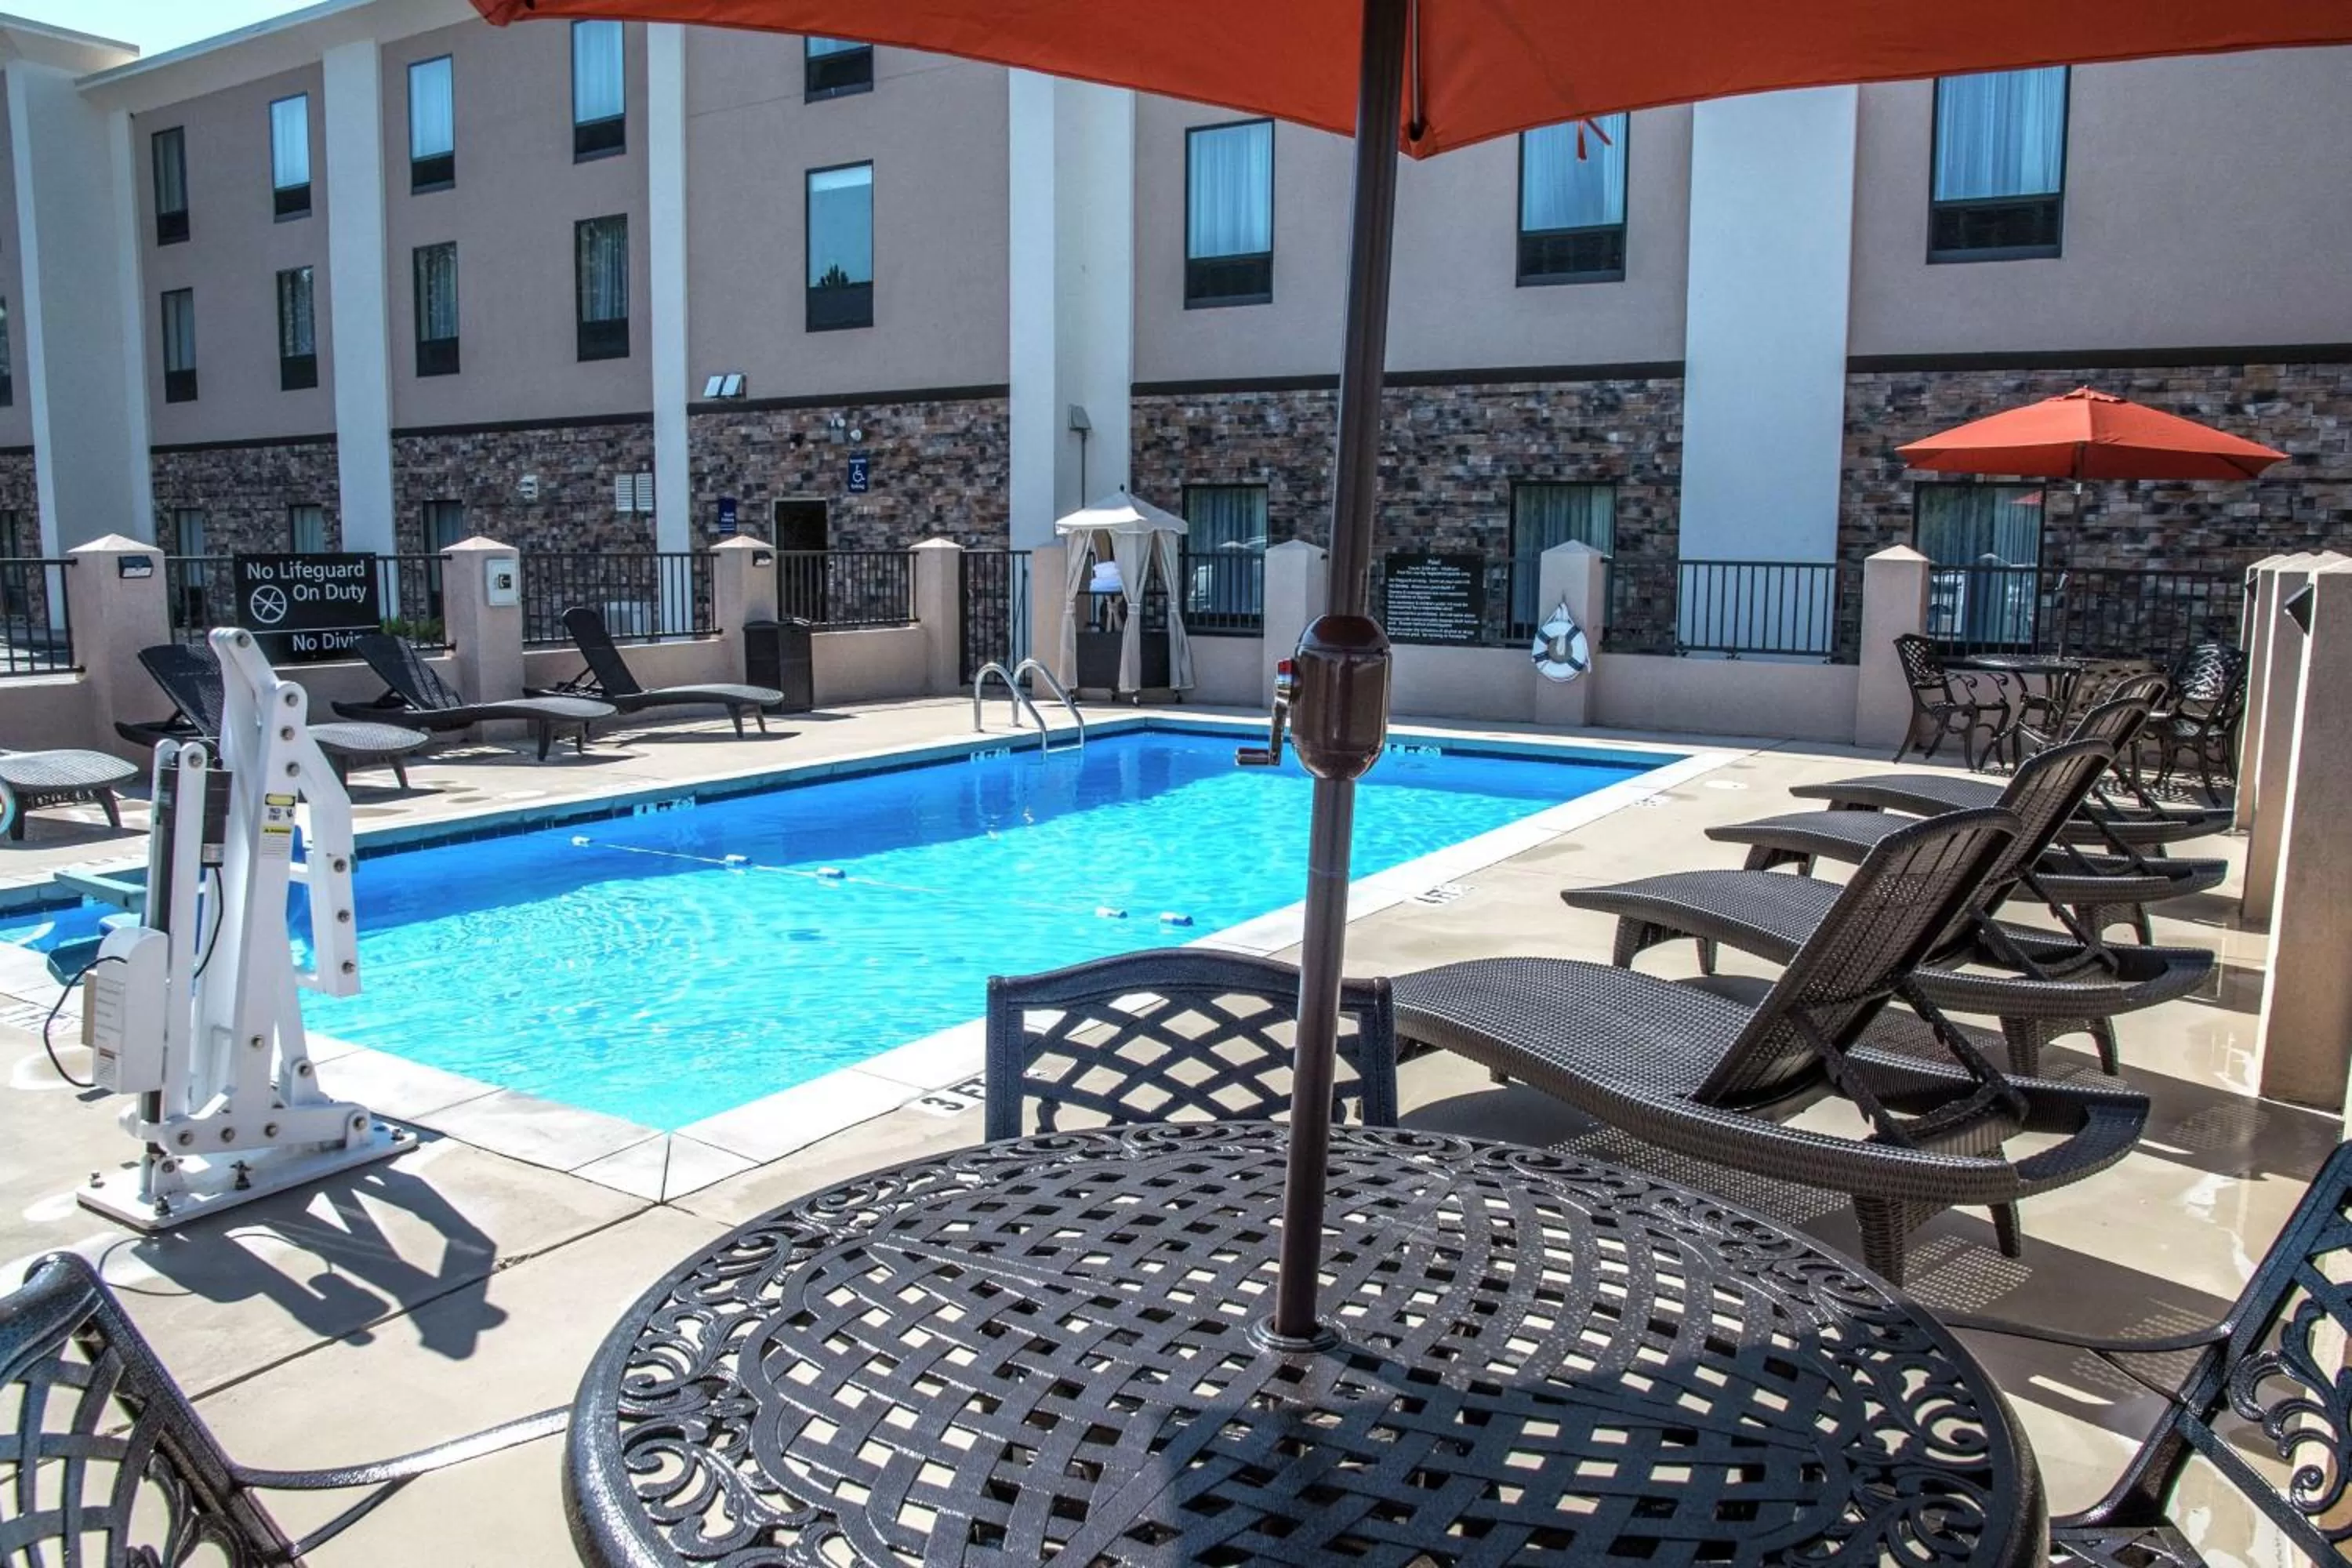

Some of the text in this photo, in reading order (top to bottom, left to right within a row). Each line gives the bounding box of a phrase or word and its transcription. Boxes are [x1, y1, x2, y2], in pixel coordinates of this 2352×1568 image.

[246, 559, 365, 583] No Lifeguard
[292, 583, 367, 603] On Duty
[292, 630, 363, 652] No Divi
[920, 1097, 965, 1111] 3
